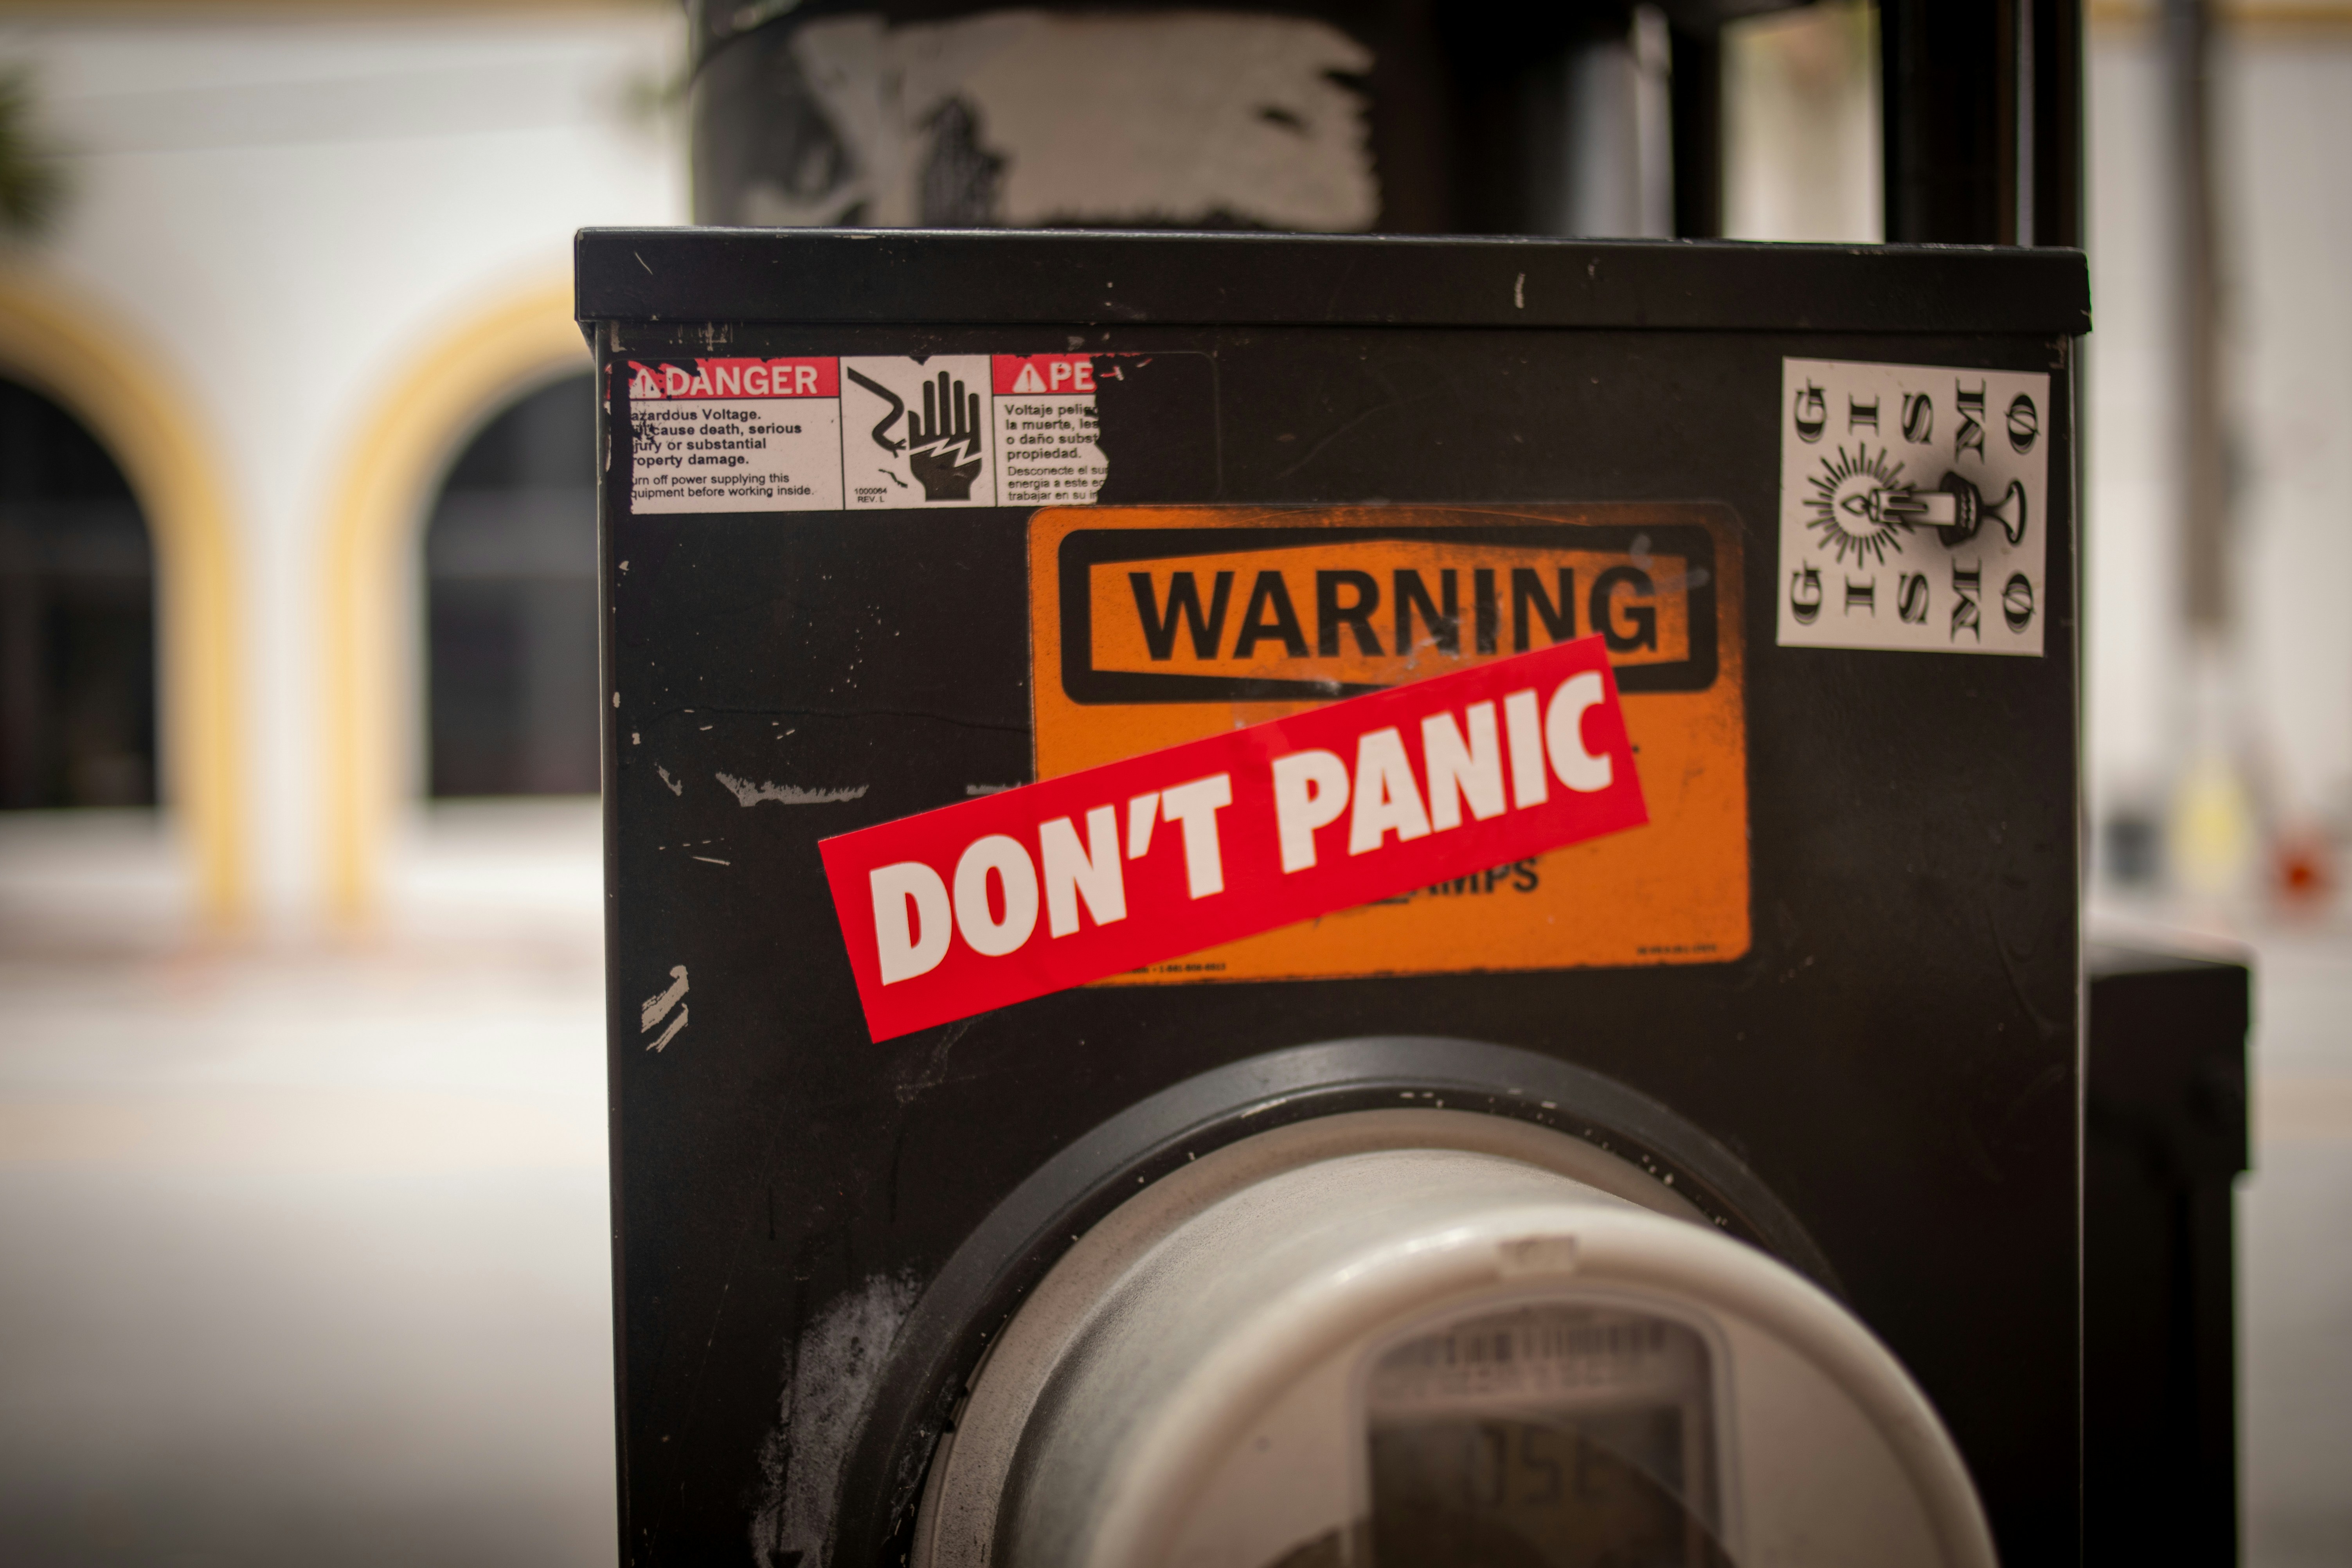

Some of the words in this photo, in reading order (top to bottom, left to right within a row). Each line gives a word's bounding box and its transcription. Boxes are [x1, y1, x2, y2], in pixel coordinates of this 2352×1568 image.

[666, 366, 818, 396] DANGER
[1050, 362, 1094, 391] PE
[702, 409, 761, 421] Voltage.
[1004, 405, 1053, 418] Voltaje
[653, 426, 695, 436] cause
[700, 424, 744, 436] death,
[749, 422, 802, 435] serious
[1006, 419, 1017, 430] la
[1022, 419, 1074, 431] muerte,
[666, 441, 682, 451] or
[687, 437, 766, 450] substantial
[1006, 436, 1015, 445] o
[1019, 433, 1054, 445] daño
[688, 454, 749, 467] damage.
[1007, 448, 1082, 462] propiedad.
[1008, 466, 1074, 476] Desconecte
[1078, 466, 1087, 475] el
[653, 475, 668, 485] off
[672, 476, 707, 487] power
[711, 474, 765, 486] supplying
[769, 473, 790, 483] this
[1064, 479, 1088, 488] este
[688, 487, 725, 497] before
[728, 485, 773, 498] working
[777, 485, 814, 495] inside.
[1008, 490, 1051, 502] trabajar
[1128, 560, 1657, 661] WARNING
[869, 773, 1232, 986] DON'T
[1272, 671, 1612, 874] PANIC
